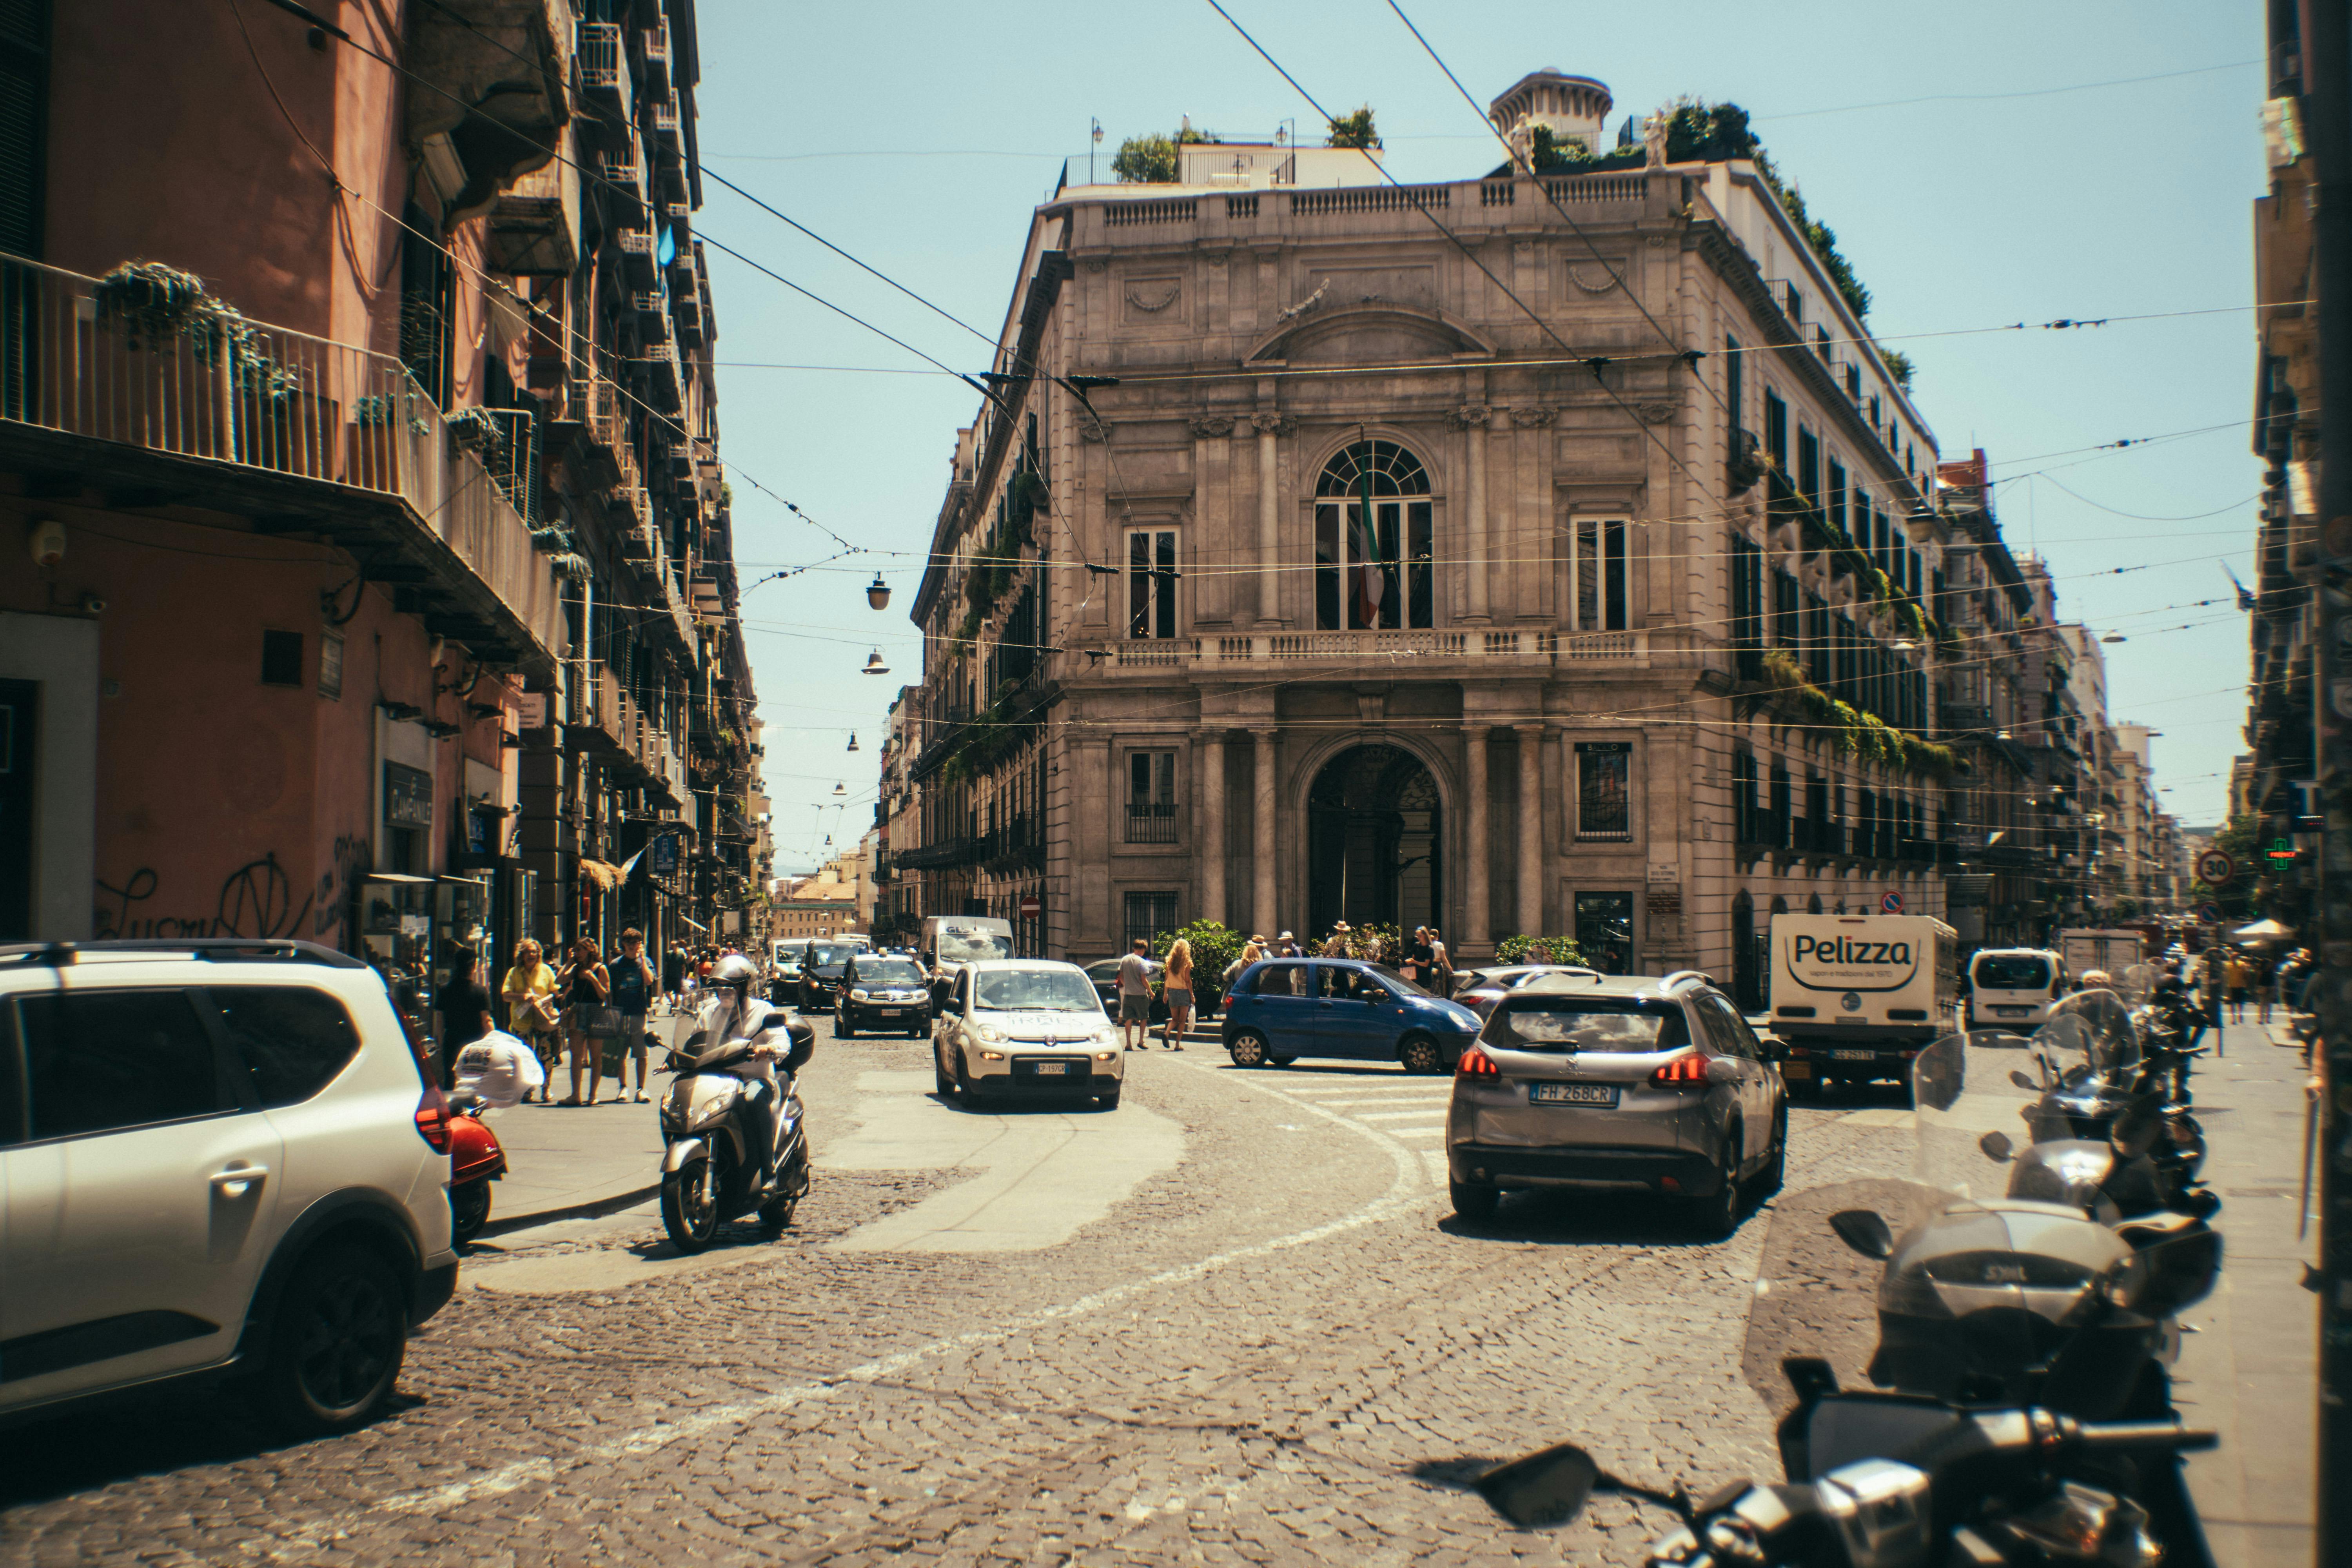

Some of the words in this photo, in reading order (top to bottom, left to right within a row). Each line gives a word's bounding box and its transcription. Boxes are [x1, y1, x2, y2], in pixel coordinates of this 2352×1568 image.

[2206, 860, 2227, 876] 30
[1795, 935, 1912, 965] Pelizza
[1541, 1085, 1558, 1099] FH
[1563, 1086, 1608, 1101] 268CR
